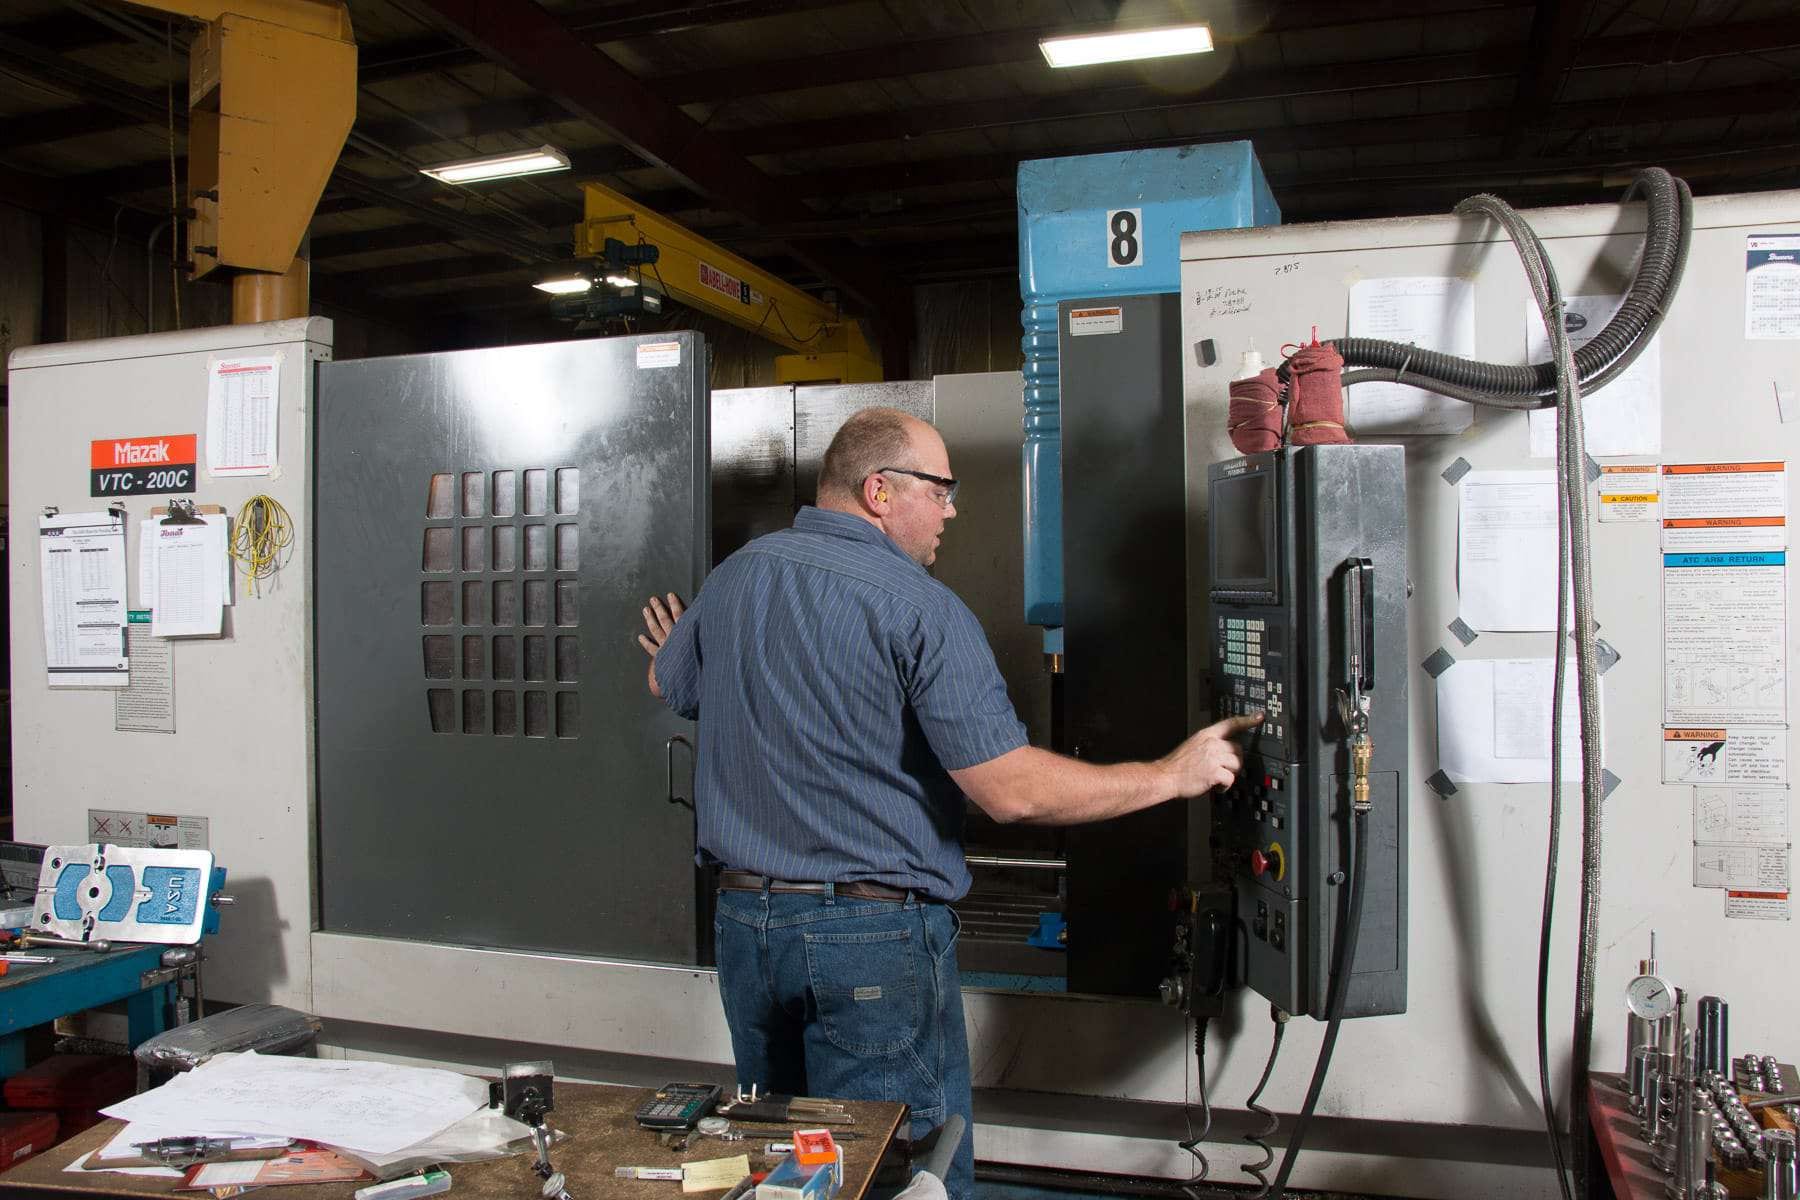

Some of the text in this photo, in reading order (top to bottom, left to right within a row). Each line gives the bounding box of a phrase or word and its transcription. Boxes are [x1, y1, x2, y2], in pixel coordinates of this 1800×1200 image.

[1110, 210, 1138, 265] 8
[114, 440, 170, 465] Mazak
[100, 472, 133, 491] VTC
[146, 470, 189, 489] 200C
[1729, 555, 1765, 563] RETURN
[165, 876, 184, 915] USA
